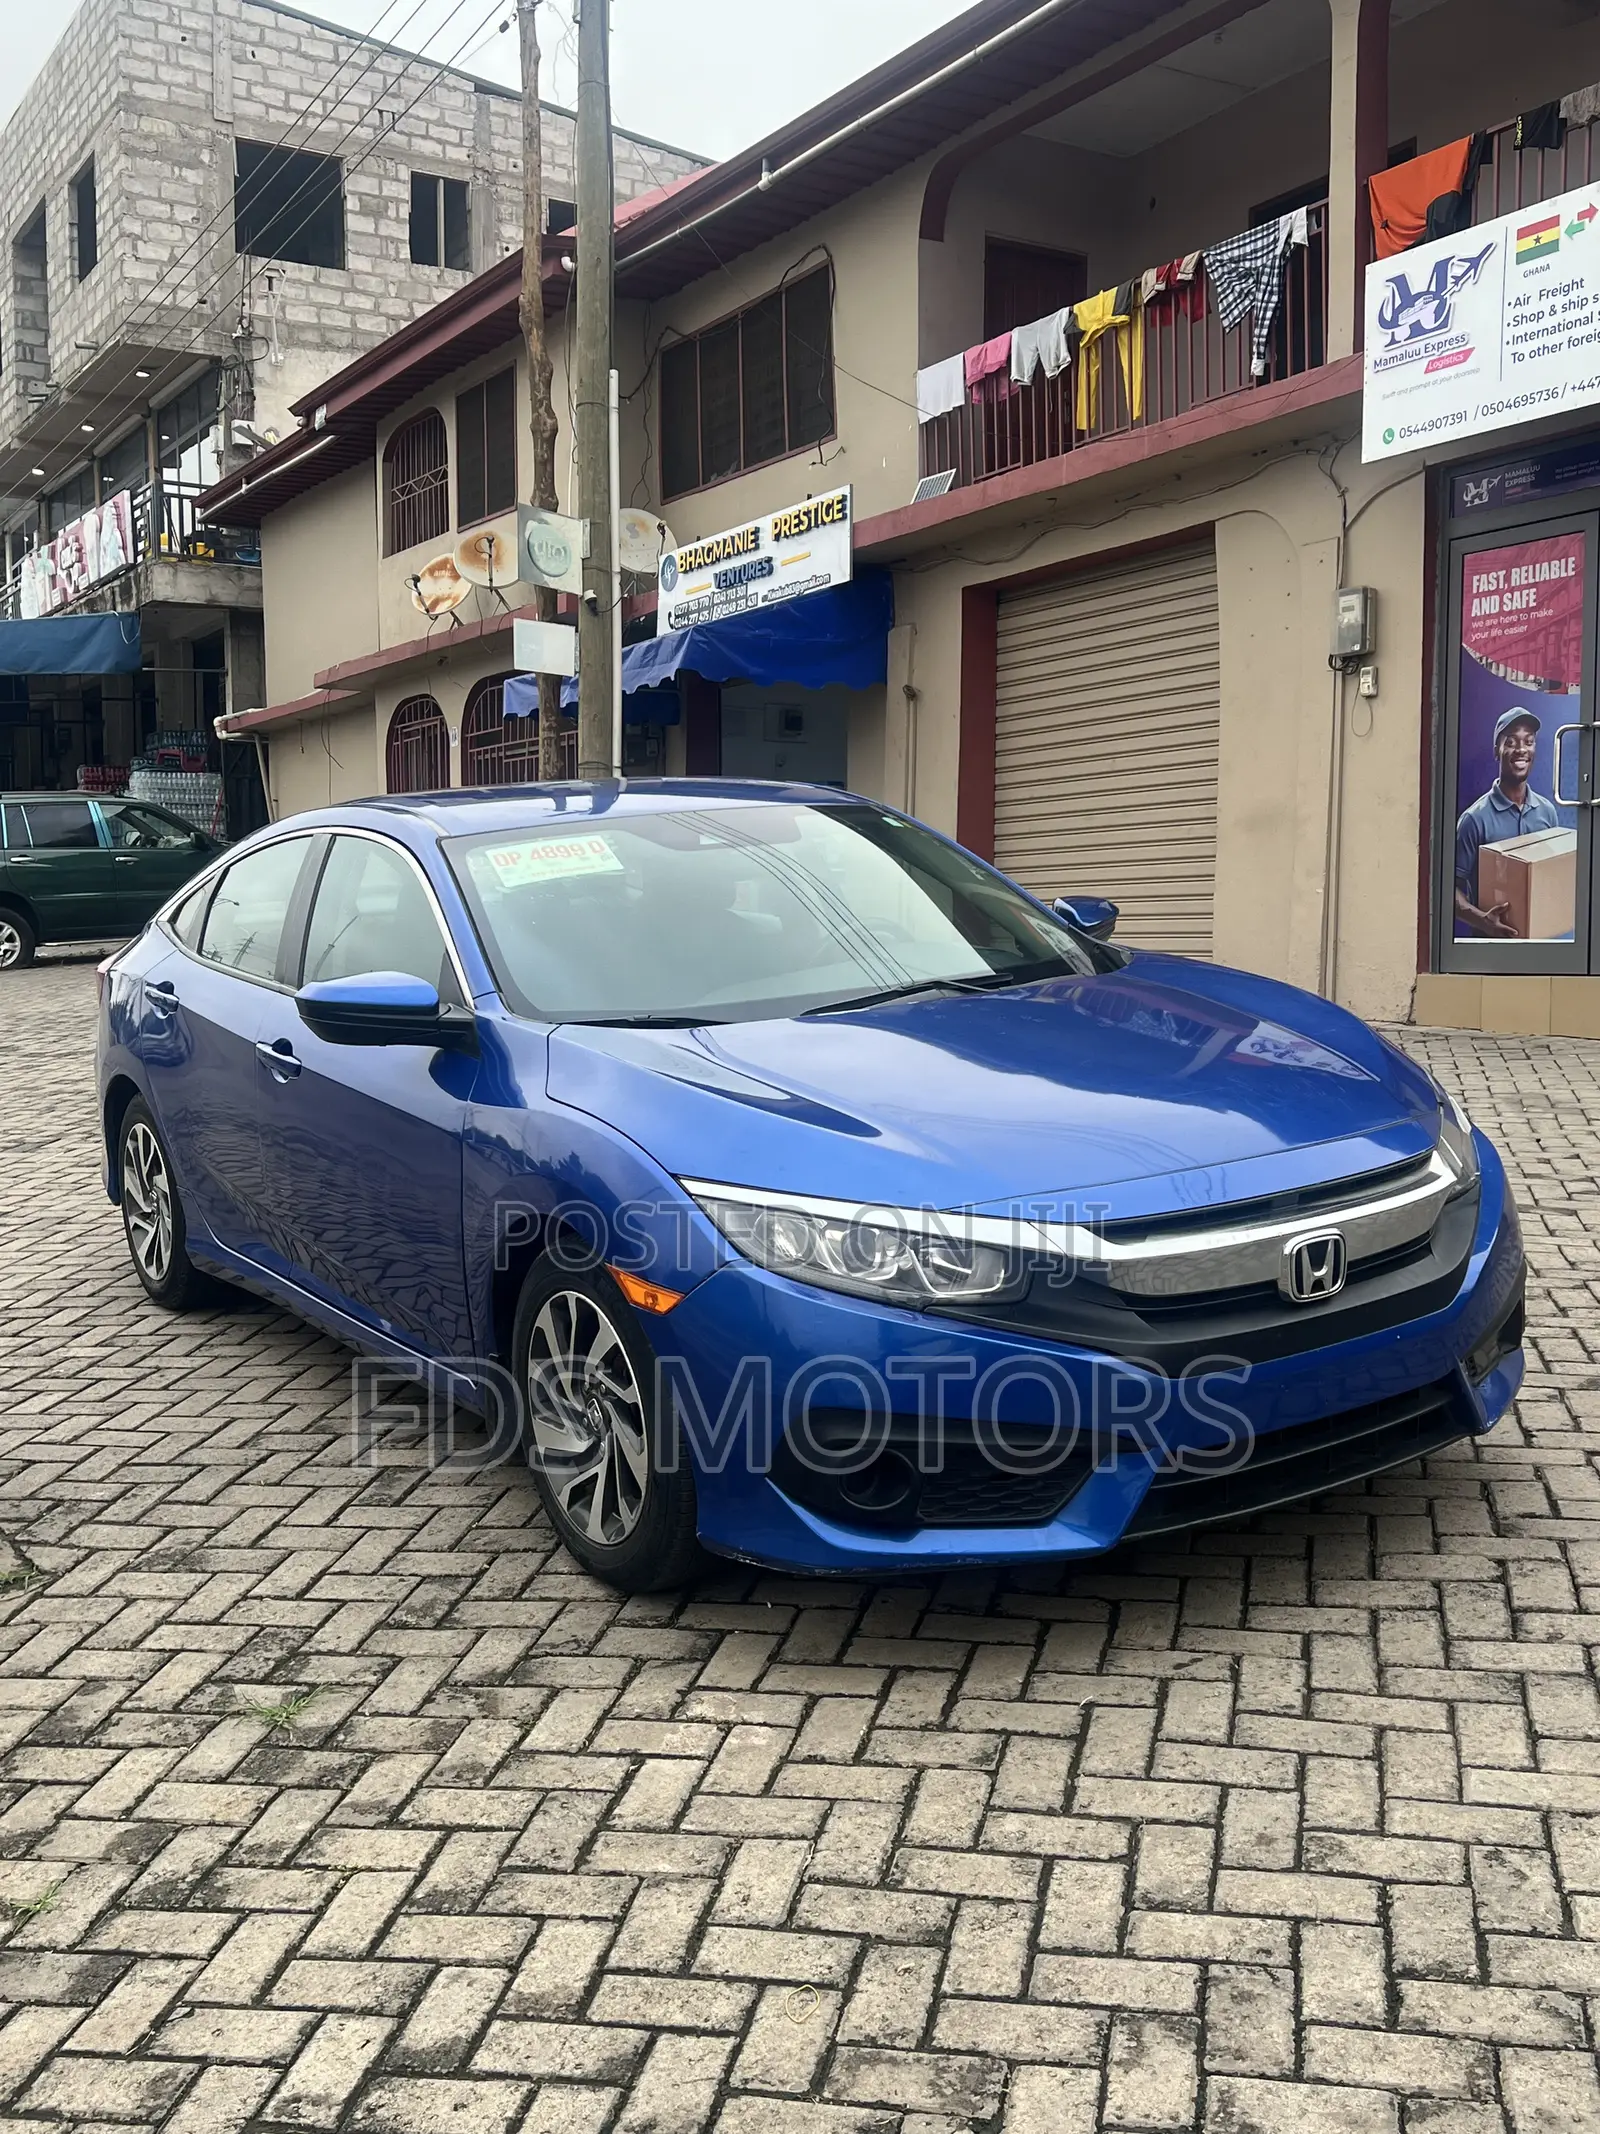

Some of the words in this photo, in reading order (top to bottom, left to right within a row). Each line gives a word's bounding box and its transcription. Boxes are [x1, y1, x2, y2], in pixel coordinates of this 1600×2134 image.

[1523, 263, 1551, 278] GHANA
[1513, 293, 1531, 309] Air
[1539, 277, 1585, 301] Freight
[1512, 310, 1545, 328] Shop
[1549, 304, 1557, 316] &
[1561, 295, 1589, 313] ship
[1512, 311, 1594, 346] International
[1373, 349, 1421, 370] Mamaluu
[1424, 333, 1467, 355] Express
[1428, 353, 1464, 370] Logistics
[1511, 352, 1525, 364] To
[1529, 342, 1564, 360] other
[1399, 410, 1467, 439] 0544907391
[1481, 386, 1560, 417] 0504695736
[1504, 464, 1541, 480] MAMALUU
[1504, 474, 1536, 488] EXPRESS
[677, 526, 759, 573] BHAGMANIE
[771, 494, 847, 541] PRESTIGE
[713, 556, 774, 589] VENTURES
[1472, 570, 1508, 594] FAST,
[1511, 556, 1576, 587] RELIABLE
[1471, 594, 1500, 617] AND
[1502, 588, 1537, 612] SAFE
[1485, 617, 1498, 627] are
[1500, 613, 1518, 624] here
[1520, 611, 1528, 620] to
[1530, 607, 1554, 619] make
[1471, 629, 1489, 642] your
[1490, 626, 1502, 637] life
[1504, 624, 1529, 636] easier
[530, 842, 587, 861] 4899
